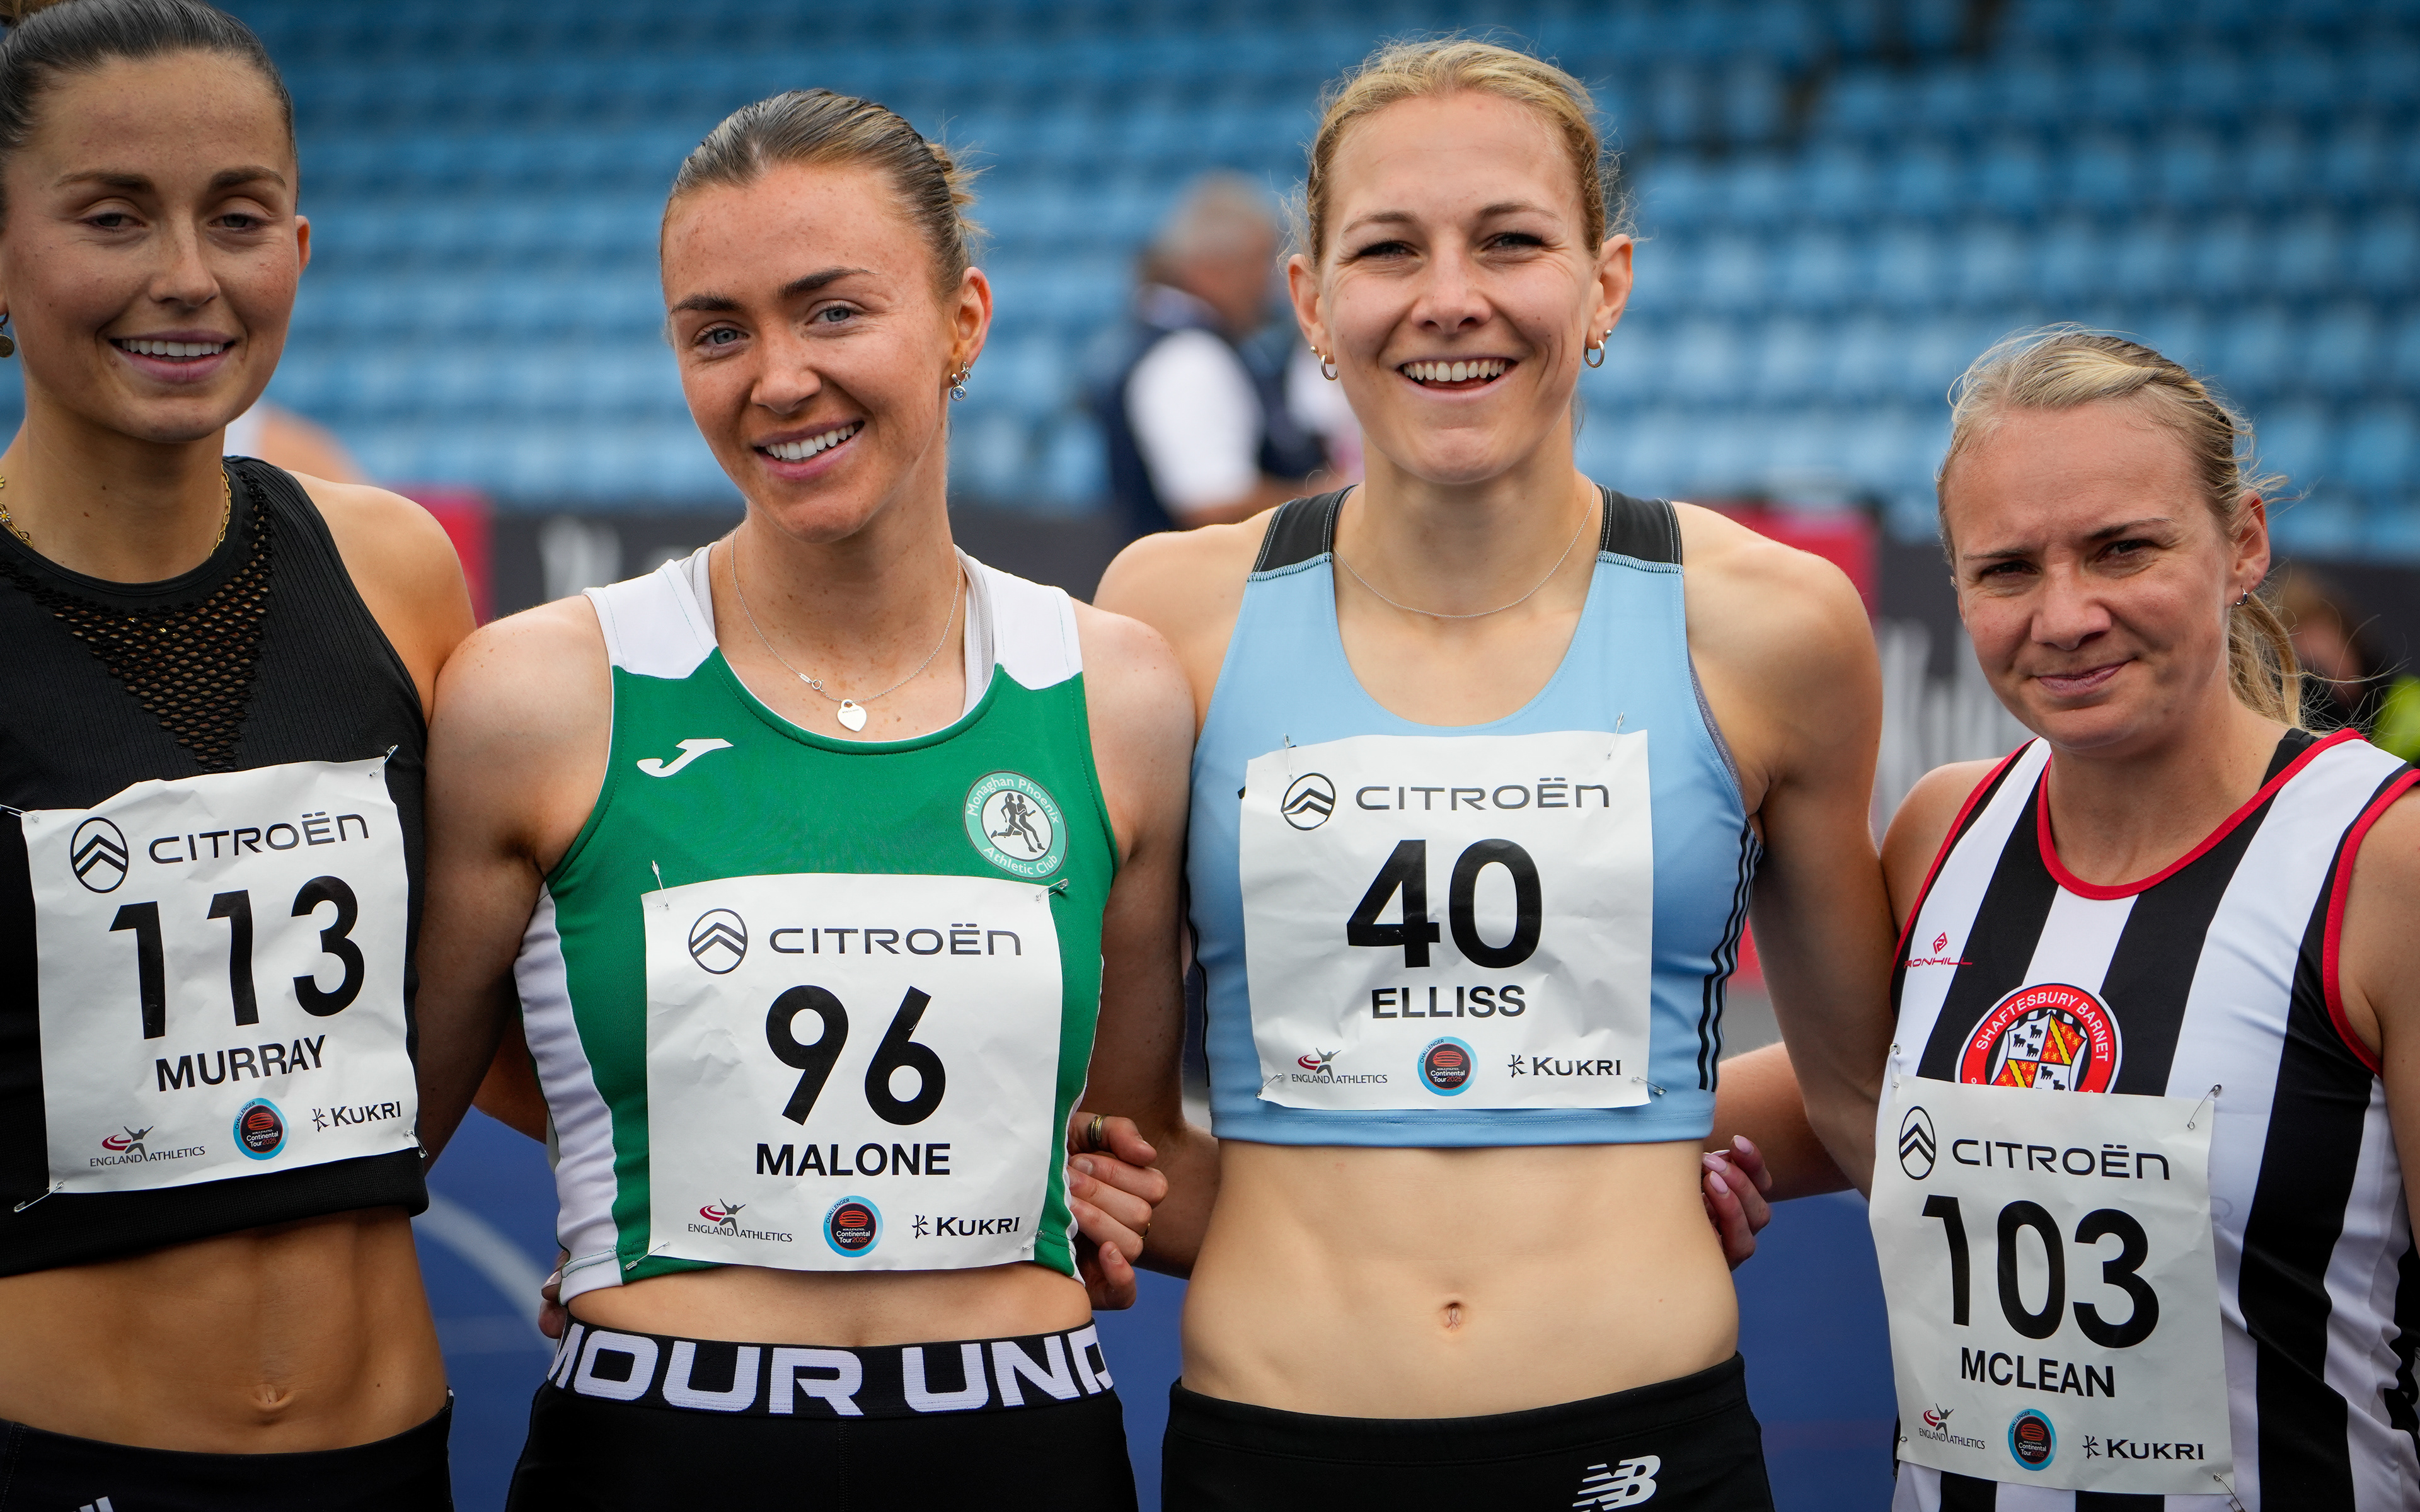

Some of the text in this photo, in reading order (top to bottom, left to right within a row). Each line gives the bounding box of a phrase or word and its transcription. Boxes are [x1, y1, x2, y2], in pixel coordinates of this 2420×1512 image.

[967, 777, 1059, 824] Monaghan Phoenix
[983, 847, 1057, 874] Athletic Club
[1346, 838, 1543, 968] 40
[108, 875, 366, 1040] 113
[1371, 985, 1526, 1019] ELLISS
[1976, 991, 2109, 1062] SHAFTESBURY BARNET
[155, 1034, 326, 1092] MURRAY
[765, 985, 947, 1126] 96
[1420, 1038, 1444, 1063] CHALLENGER
[1291, 1074, 1388, 1084] ENGLAND ATHLETICS
[1532, 1056, 1622, 1076] KUKRI
[234, 1101, 256, 1130] CHALLENGER
[330, 1101, 401, 1128] KUKRI
[246, 1131, 279, 1142] Continental
[90, 1146, 205, 1167] ENGLAND ATHLETICS
[756, 1143, 951, 1176] MALONE
[826, 1198, 850, 1223] CHALLENGER
[688, 1223, 793, 1242] ENGLAND ATHLETICS
[936, 1217, 1020, 1237] KUKRI
[1922, 1194, 2160, 1348] 103
[1961, 1346, 2116, 1398] MCLEAN
[2010, 1411, 2031, 1434] CHALLENGER
[1918, 1427, 1985, 1450] ENGLAND ATHLETICS
[2019, 1442, 2047, 1452] Continental
[2106, 1438, 2204, 1460] KUKRI
